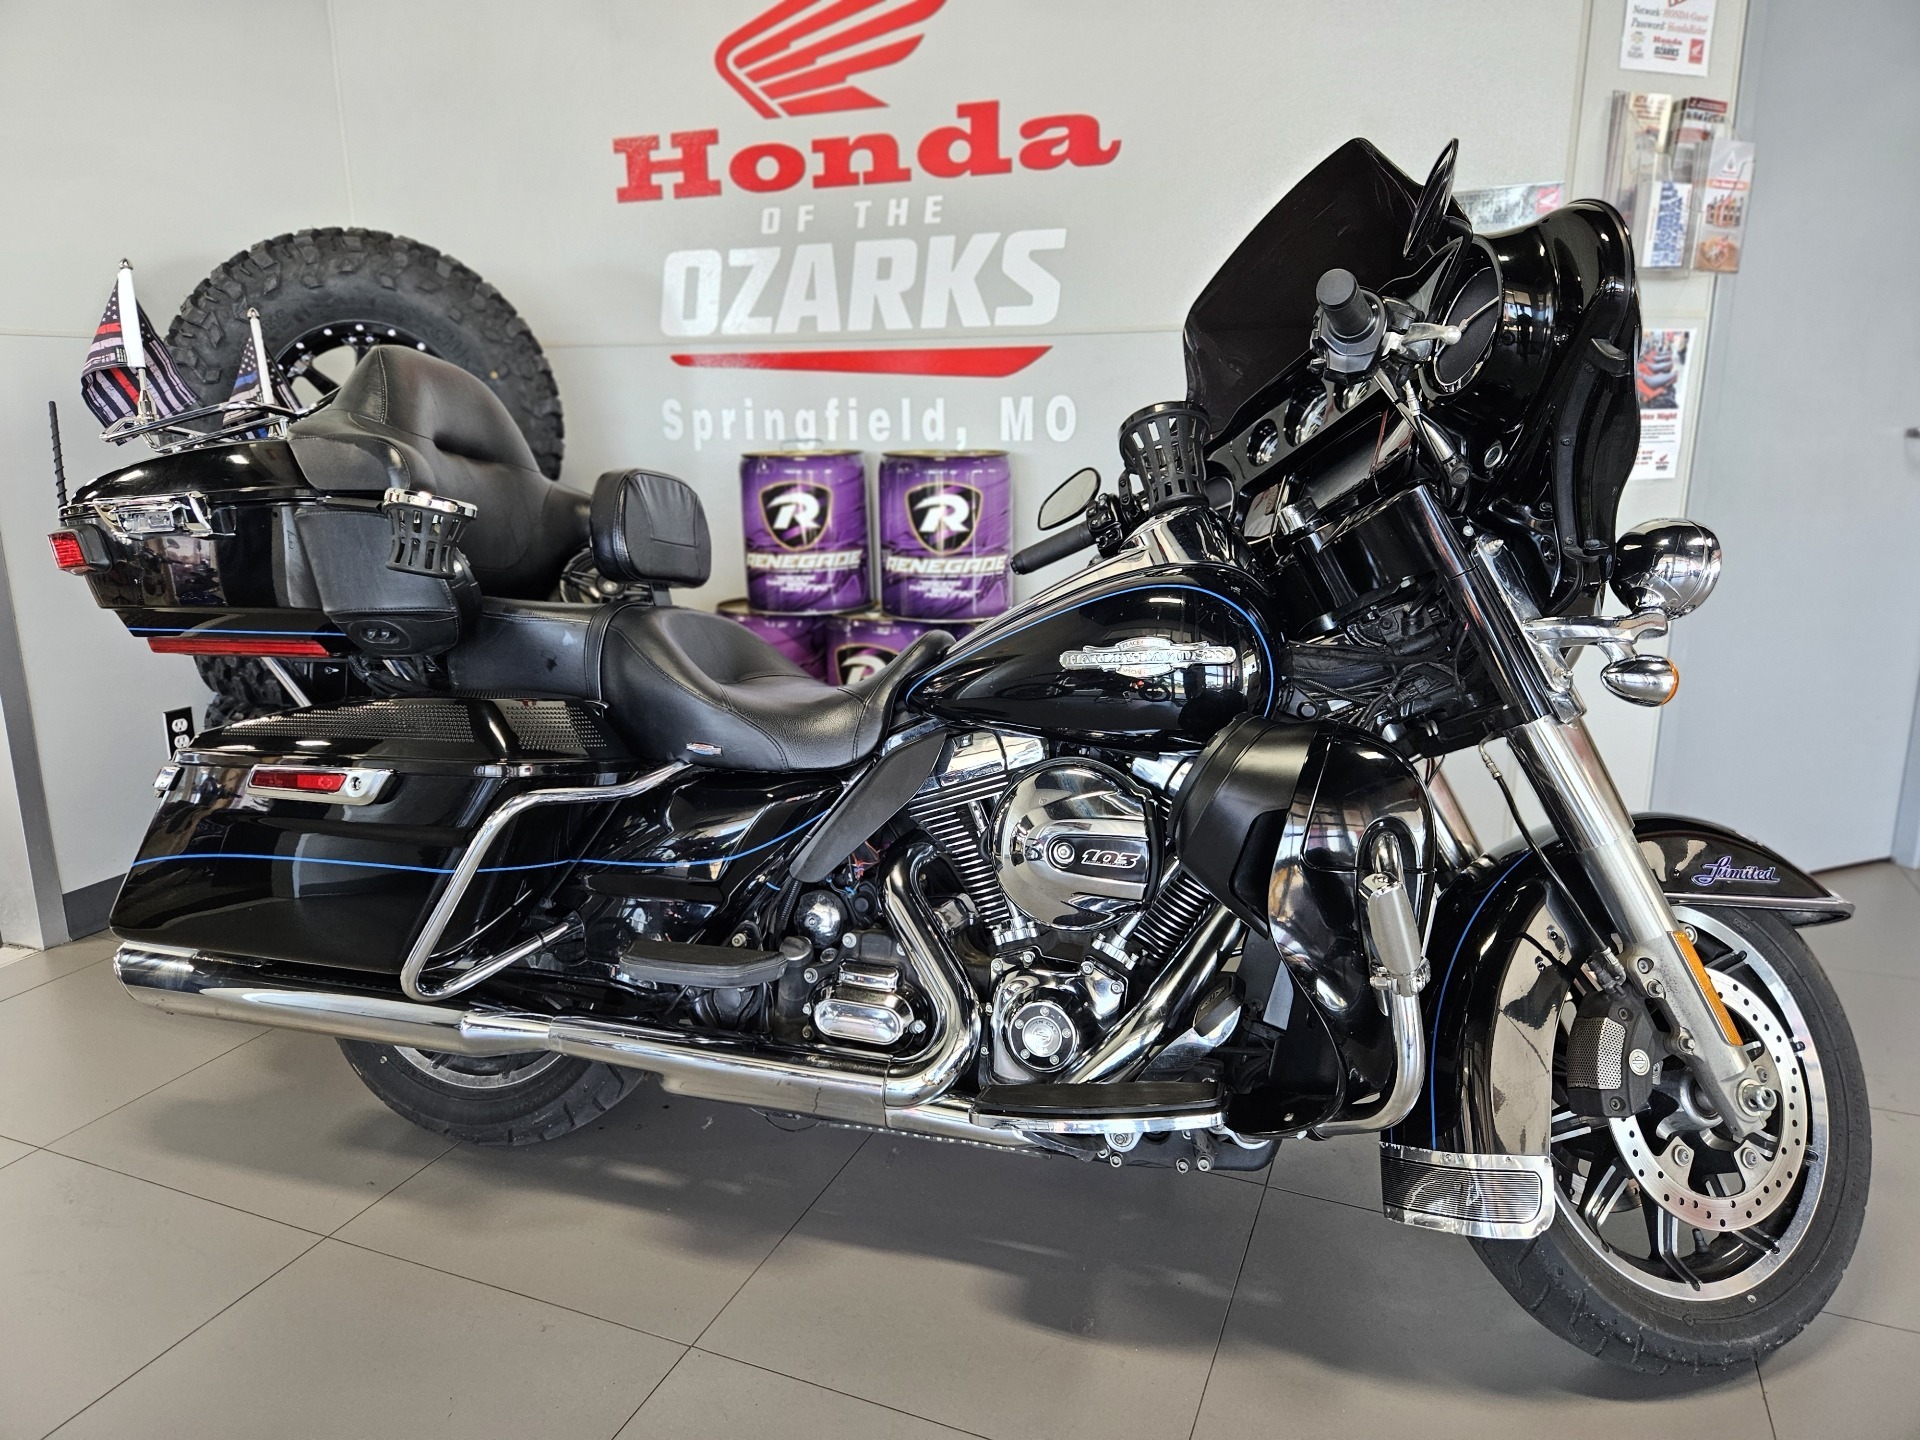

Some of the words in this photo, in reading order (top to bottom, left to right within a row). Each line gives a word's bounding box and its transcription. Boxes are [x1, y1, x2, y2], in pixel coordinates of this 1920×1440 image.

[1653, 35, 1683, 46] Honda
[612, 99, 1122, 203] Honda
[761, 204, 815, 235] OF
[854, 195, 944, 229] THE
[660, 228, 1068, 338] OZARKS
[661, 396, 967, 451] Springfield,
[1000, 394, 1078, 443] MO
[767, 491, 821, 530] R
[913, 493, 970, 532] R
[747, 549, 864, 570] RENEGADE
[886, 554, 1009, 575] RENEGADE
[1081, 849, 1142, 869] 103
[1691, 855, 1781, 887] Limited
